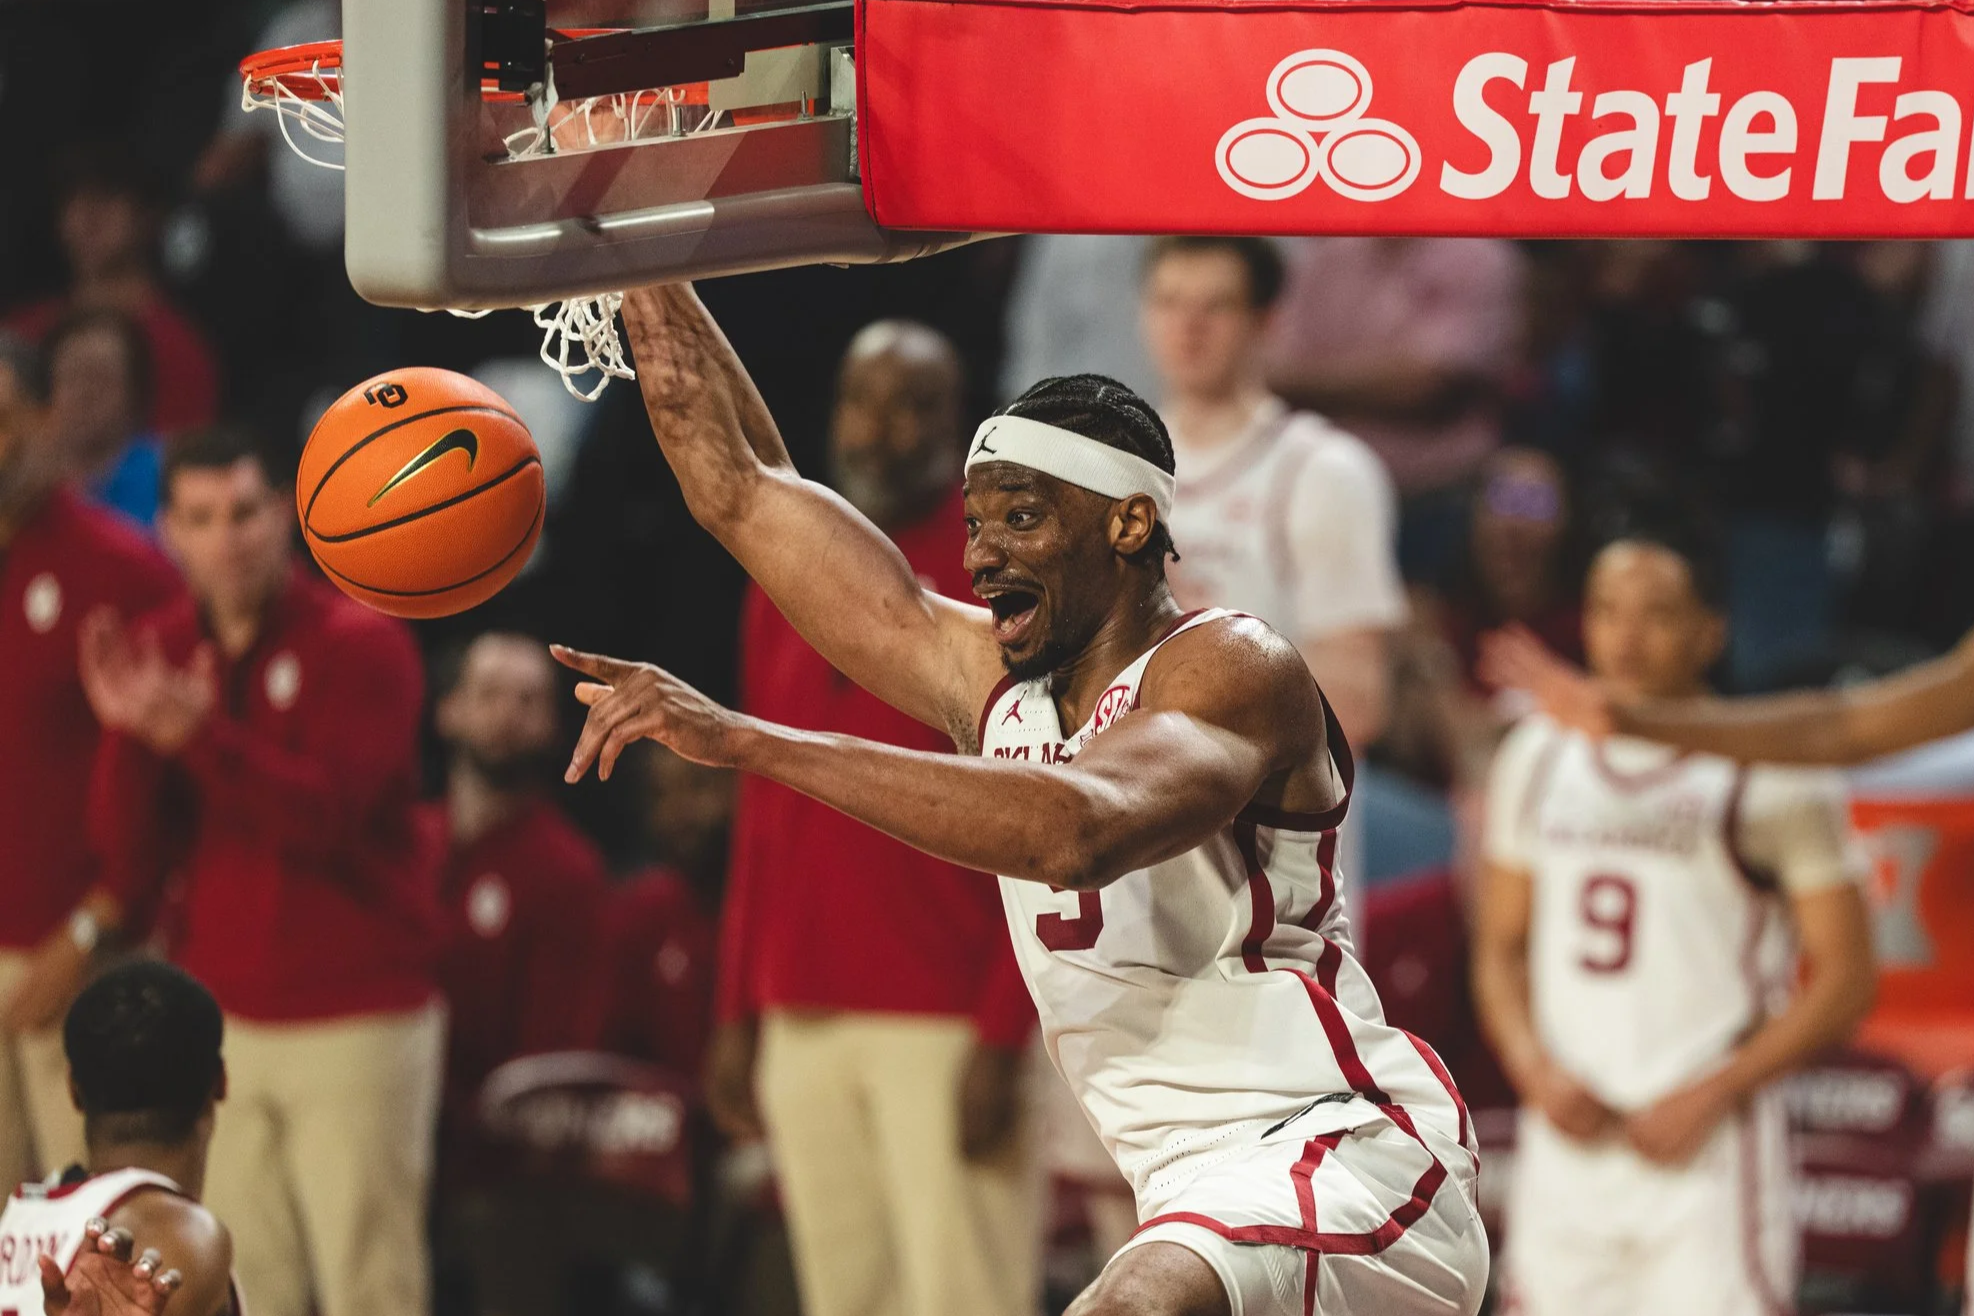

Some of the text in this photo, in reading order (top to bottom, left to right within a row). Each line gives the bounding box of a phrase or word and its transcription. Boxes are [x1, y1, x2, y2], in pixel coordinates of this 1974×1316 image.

[1440, 52, 1974, 203] State Fa
[1574, 872, 1638, 976] 9
